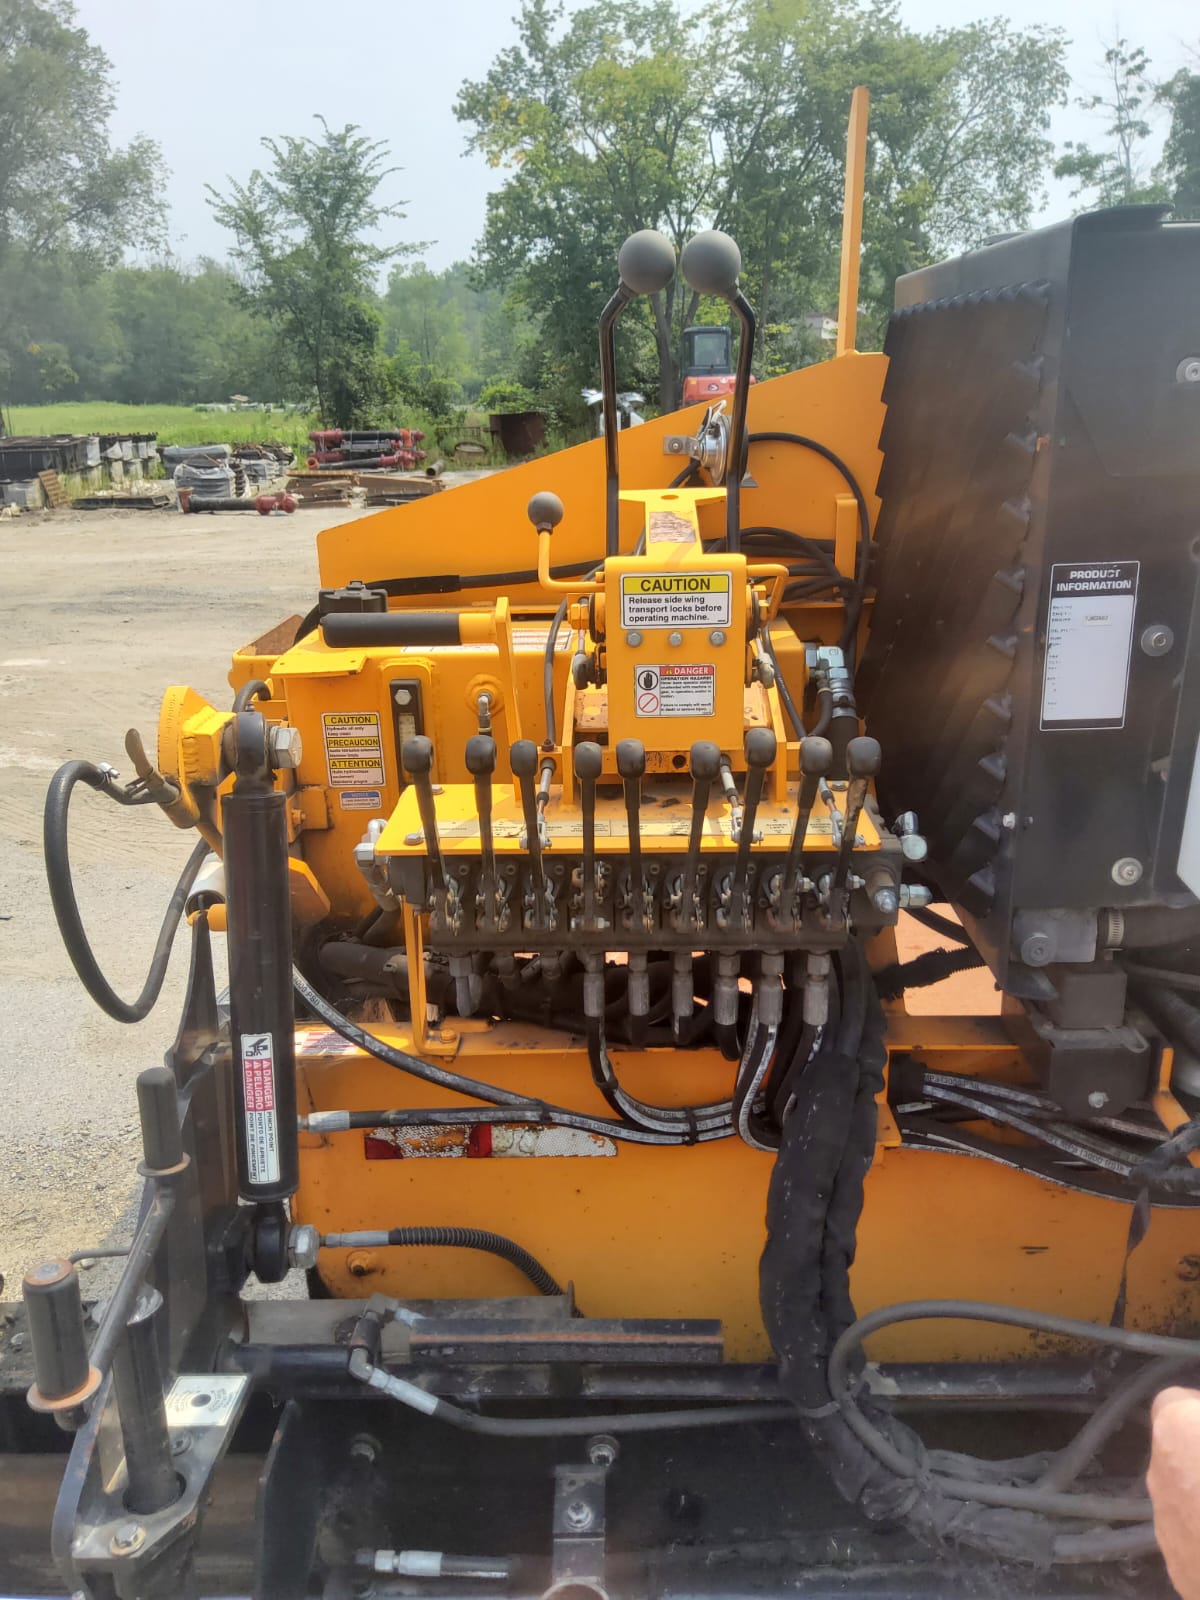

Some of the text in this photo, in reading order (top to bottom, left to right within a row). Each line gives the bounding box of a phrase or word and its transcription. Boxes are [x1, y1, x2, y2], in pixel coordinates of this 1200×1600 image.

[1070, 570, 1120, 580] PRODUCT
[640, 578, 710, 592] CAUTION
[1056, 580, 1132, 592] INFORMATION
[684, 596, 704, 604] wing
[629, 606, 668, 614] transport
[629, 615, 668, 623] operating
[672, 614, 710, 622] machine.
[330, 716, 372, 724] CAUTION
[245, 1070, 254, 1108] DANGER
[254, 1069, 263, 1110] PELIGRO
[263, 1070, 273, 1108] DANGER
